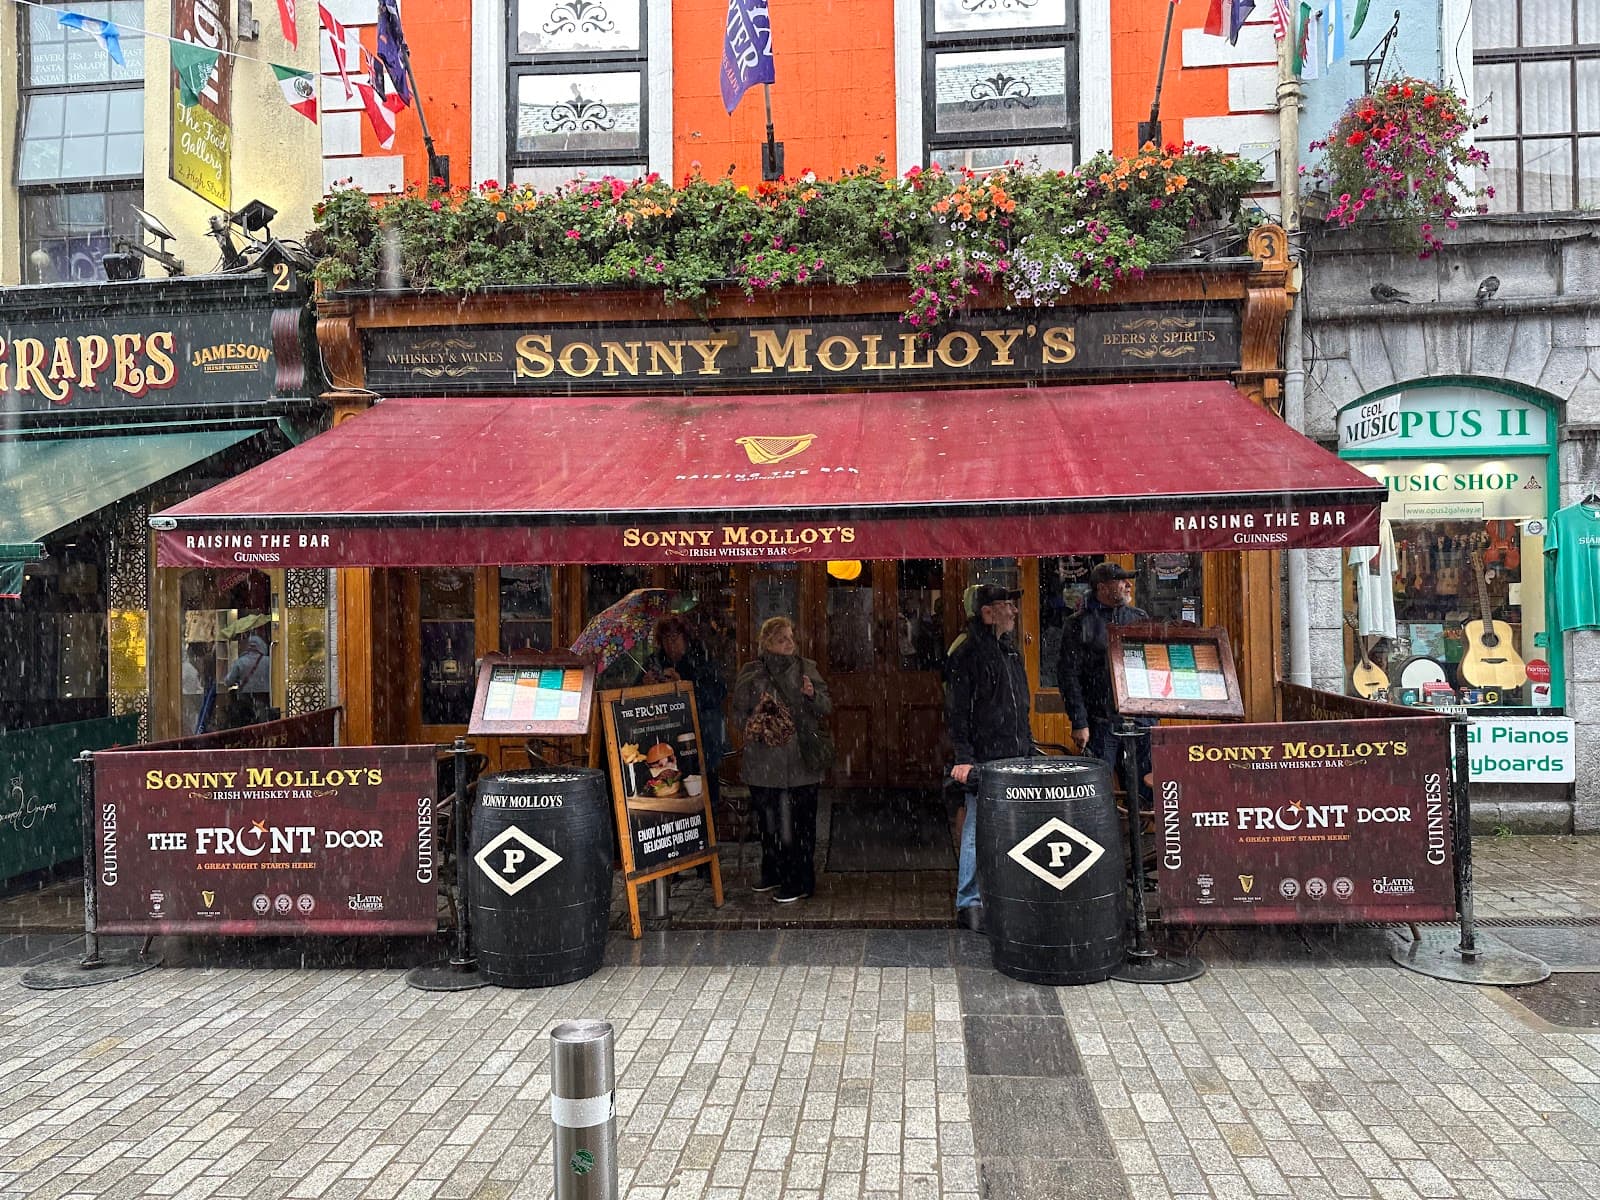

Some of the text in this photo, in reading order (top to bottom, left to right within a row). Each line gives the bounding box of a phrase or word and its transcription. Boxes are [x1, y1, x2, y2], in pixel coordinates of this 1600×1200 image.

[176, 103, 228, 153] The Food
[181, 132, 223, 179] Gallery
[185, 167, 206, 191] High
[1260, 234, 1276, 259] 3
[273, 263, 290, 292] 2
[1103, 330, 1217, 346] BEERS & SPIRITS
[192, 343, 268, 367] JAMESON
[387, 351, 503, 365] WHISKEY & WINES
[515, 324, 1077, 379] SONNY MOLLOY'S
[226, 364, 259, 372] WHISKEY
[1361, 402, 1383, 419] CEOL
[1345, 411, 1399, 444] MUSIC
[1496, 408, 1531, 437] II
[1453, 472, 1519, 491] SHOP
[1174, 511, 1346, 531] RAISING THE BAR
[1406, 505, 1482, 517] www.opus2galway.ie
[186, 534, 330, 549] RAISING THE BAR
[622, 526, 856, 547] SONNY MOLLOY'S
[1233, 532, 1288, 544] GUINNESS
[233, 551, 280, 563] GUINNESS
[689, 546, 788, 558] IRISH WHISKEY BAR
[1124, 649, 1144, 659] MENU
[520, 671, 540, 679] MENU
[621, 702, 685, 718] THE FRONT DOOR
[1491, 726, 1569, 744] Pianos
[1188, 740, 1408, 762] SONNY MOLLOY'S
[1251, 759, 1344, 770] IRISH WHISKEY BAR
[146, 767, 383, 790] SONNY MOLLOY'S
[213, 789, 313, 801] IRISH WHISKEY BAR
[481, 794, 563, 808] SONNY MOLLOYS
[1006, 784, 1096, 800] SONNY MOLLOYS
[1162, 780, 1182, 870] GUINNESS
[1192, 804, 1412, 831] THE FRONT DOOR
[1425, 773, 1446, 866] GUINNESS
[637, 814, 702, 843] ENJOY A PINT WITH OUR
[102, 803, 118, 887] GUINNESS
[147, 825, 384, 857] THE FRONT DOOR
[417, 797, 433, 884] GUINNESS
[643, 828, 700, 854] DELICIOUS PUB GRUB
[502, 849, 526, 873] P
[1047, 841, 1073, 867] P
[1372, 883, 1415, 894] QUARTER
[1381, 876, 1414, 886] LATIN
[348, 900, 384, 910] QUARTER
[356, 893, 382, 903] LATIN
